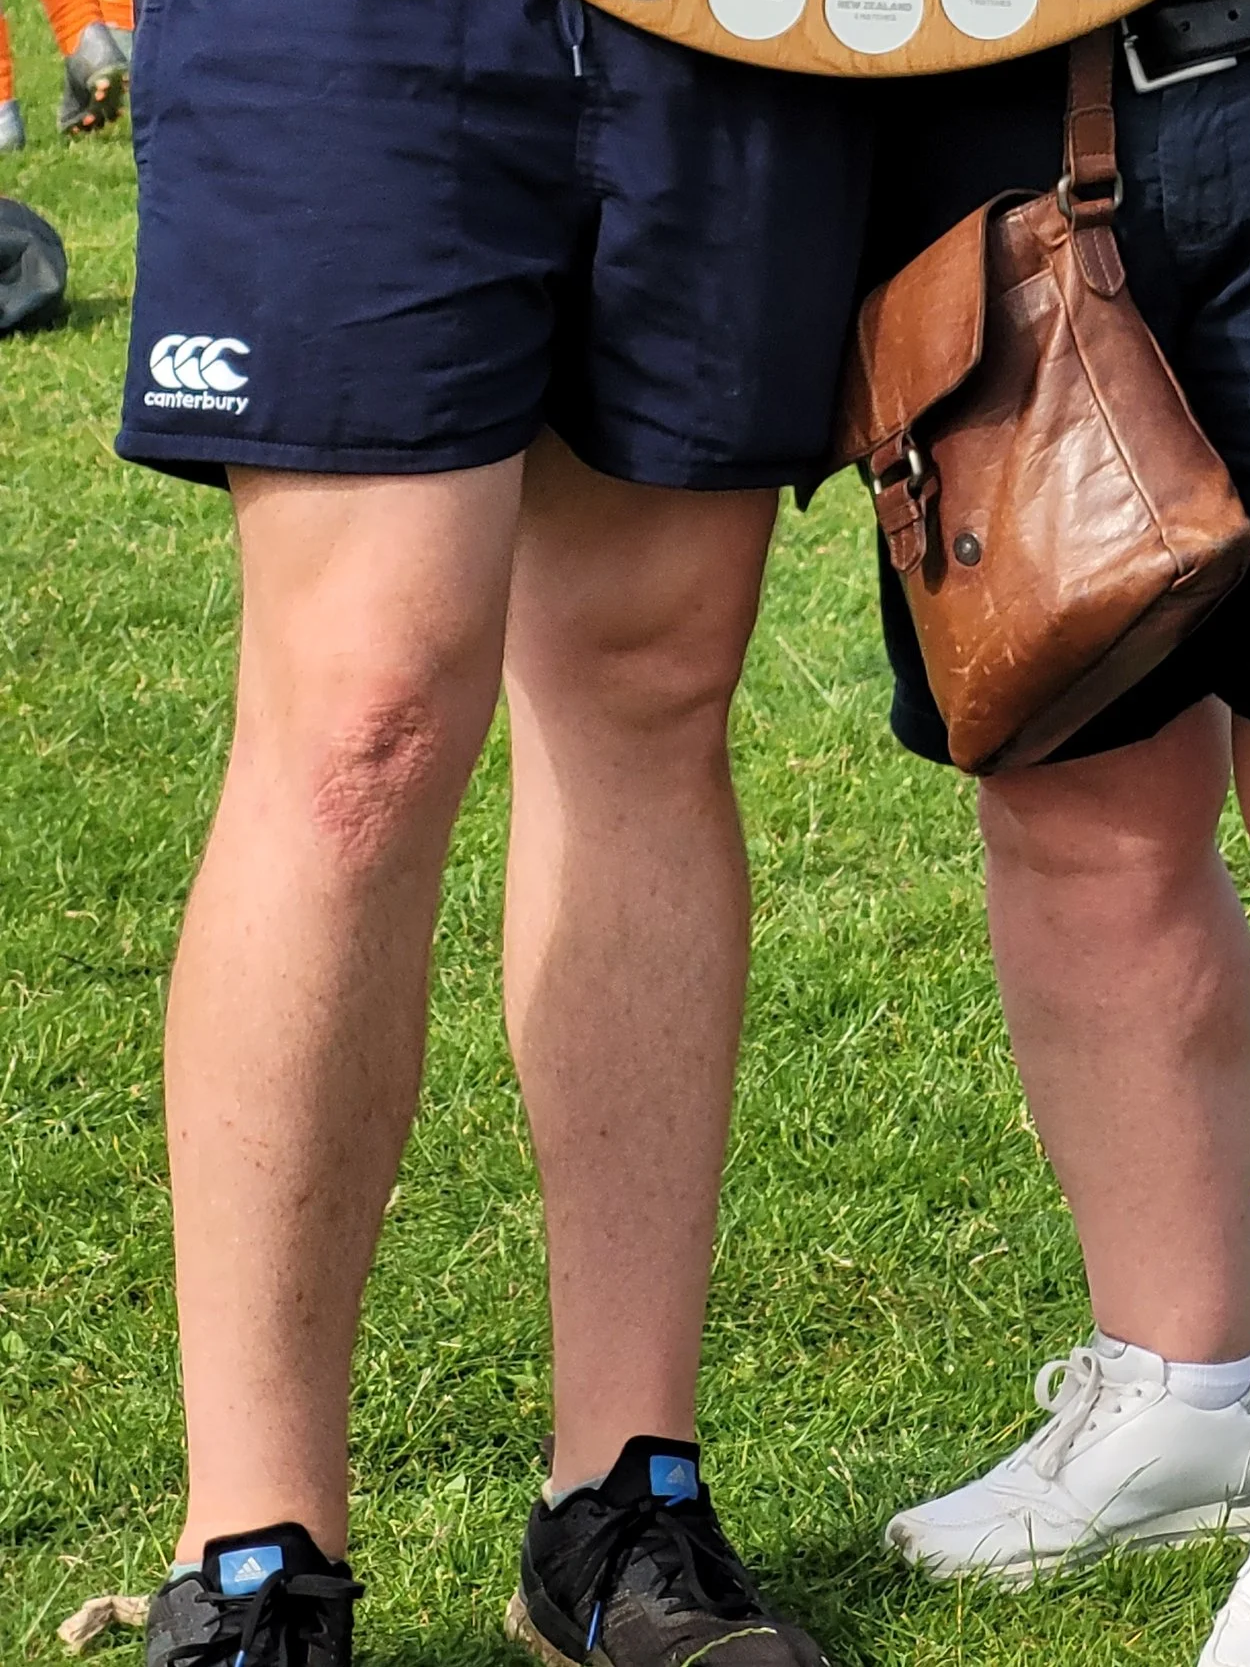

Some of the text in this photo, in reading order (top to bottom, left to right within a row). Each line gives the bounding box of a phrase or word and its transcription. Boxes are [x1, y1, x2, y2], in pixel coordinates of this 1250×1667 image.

[837, 0, 913, 12] NEW ZEALAND
[144, 390, 249, 415] canterbury
